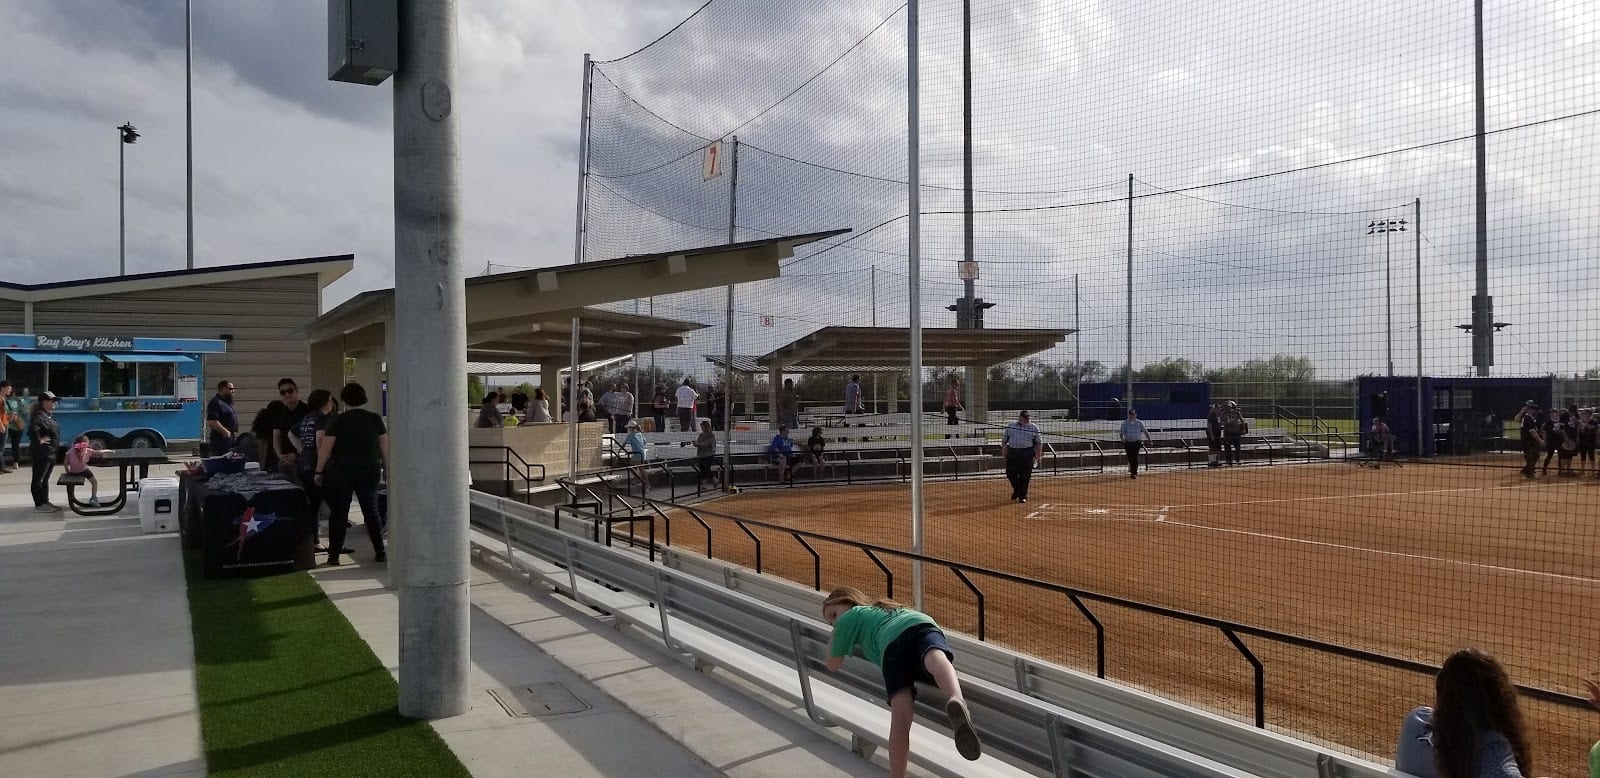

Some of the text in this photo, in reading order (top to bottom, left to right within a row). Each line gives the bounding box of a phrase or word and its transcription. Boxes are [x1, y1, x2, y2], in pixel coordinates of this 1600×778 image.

[710, 146, 717, 175] 7
[37, 335, 133, 350] Ray Ray's Kitchen
